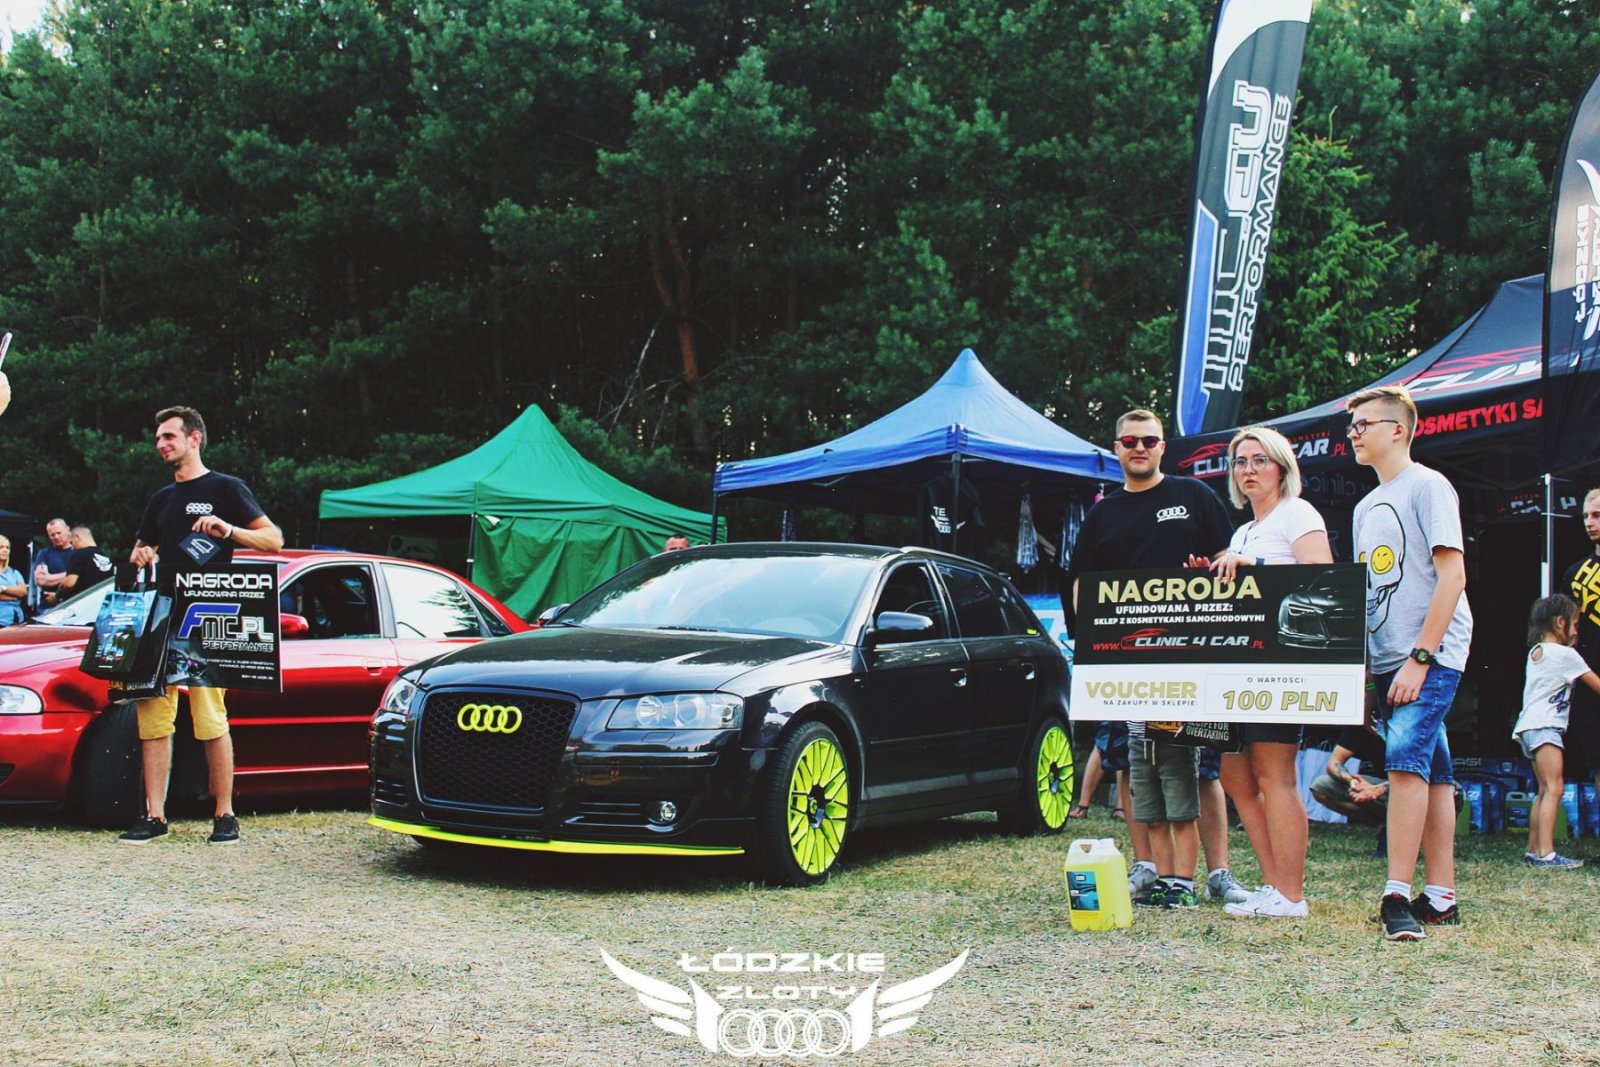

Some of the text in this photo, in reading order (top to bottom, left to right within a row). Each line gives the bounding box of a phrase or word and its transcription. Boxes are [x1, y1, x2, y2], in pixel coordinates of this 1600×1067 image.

[1227, 93, 1292, 392] PERFORMANCE
[1413, 401, 1517, 438] OSMETYKI
[176, 572, 273, 590] NAGRODA
[1098, 575, 1262, 604] NAGRODA
[1116, 603, 1233, 615] UFUNDOWANA PRZEZ:
[1094, 614, 1265, 625] SKLEP Z KOSMETYKAMI SAMOCHODOWYMI
[202, 641, 274, 653] PERFORMANCE
[1134, 636, 1189, 647] CLINIC
[1192, 636, 1204, 646] 4
[1210, 636, 1250, 647] CAR
[1085, 681, 1197, 699] VOUCHER
[1222, 690, 1338, 712] 100 PLN
[1185, 725, 1230, 741] OVERTAKING
